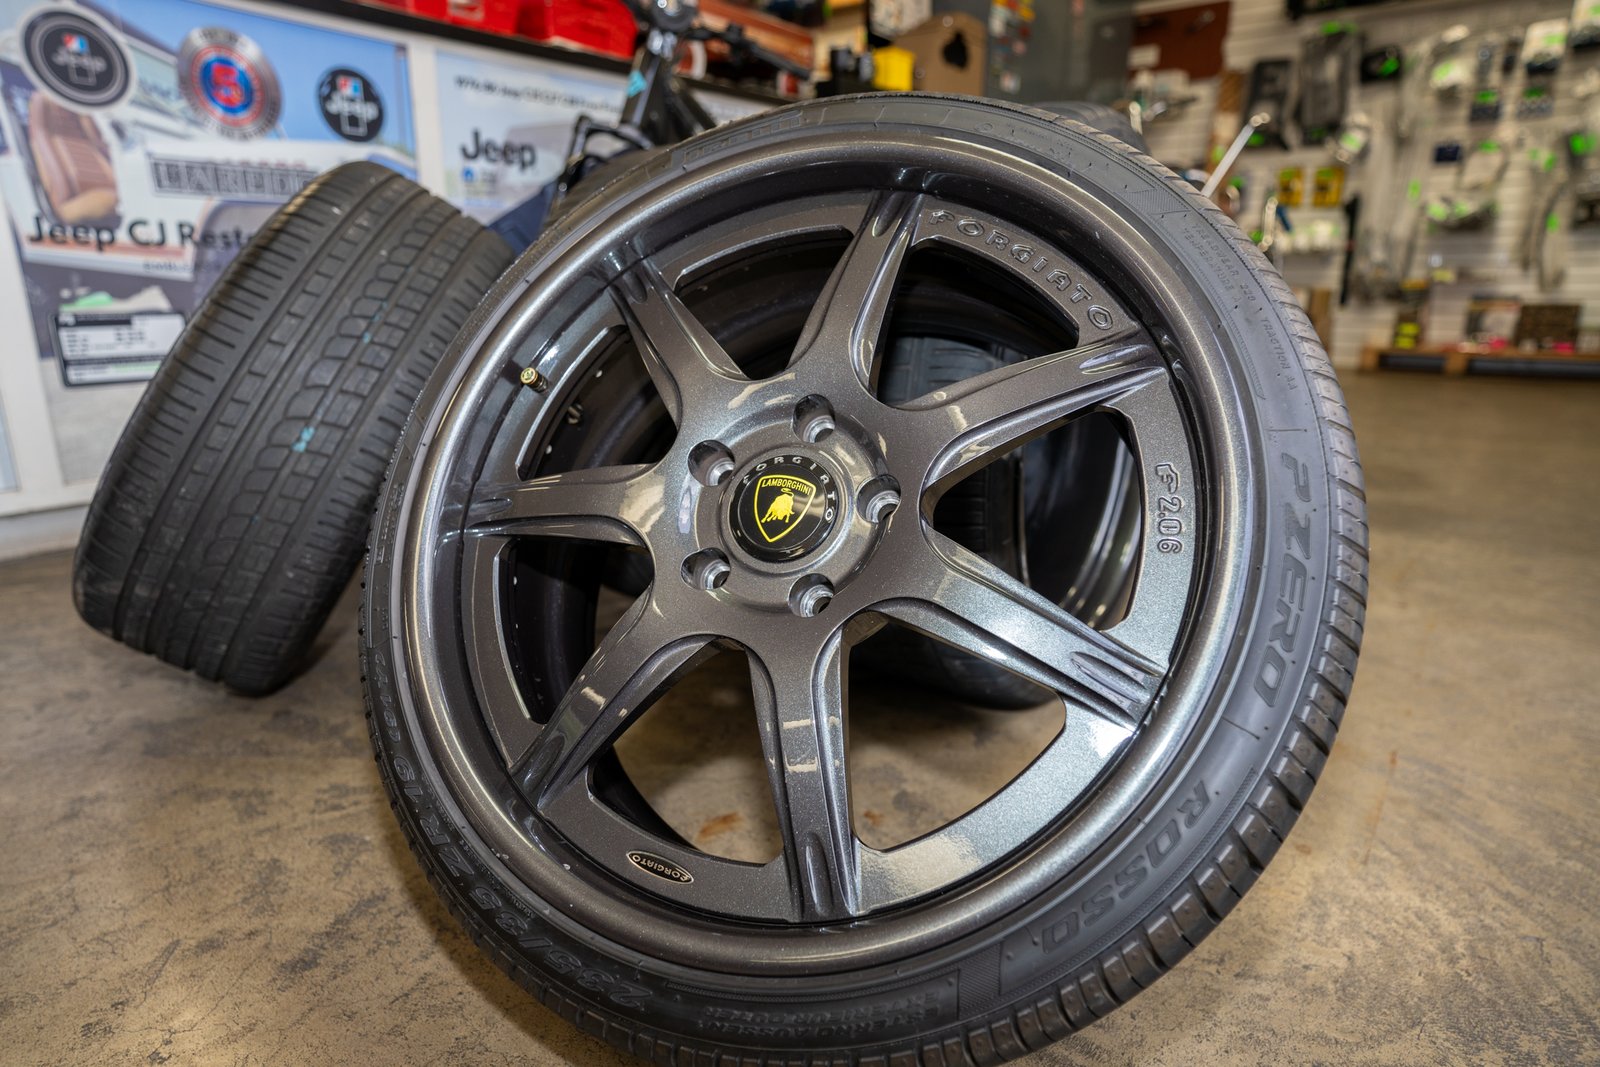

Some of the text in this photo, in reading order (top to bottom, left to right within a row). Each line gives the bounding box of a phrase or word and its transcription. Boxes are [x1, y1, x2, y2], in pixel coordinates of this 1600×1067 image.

[325, 89, 379, 123] Jeep
[461, 127, 537, 171] Jeep
[28, 216, 252, 251] Jeep CJ Rest
[927, 209, 1115, 331] FORGIATO
[762, 479, 812, 496] LAMBORGHINI
[632, 853, 691, 882] FORGIATO
[1042, 780, 1211, 954] ROSSO
